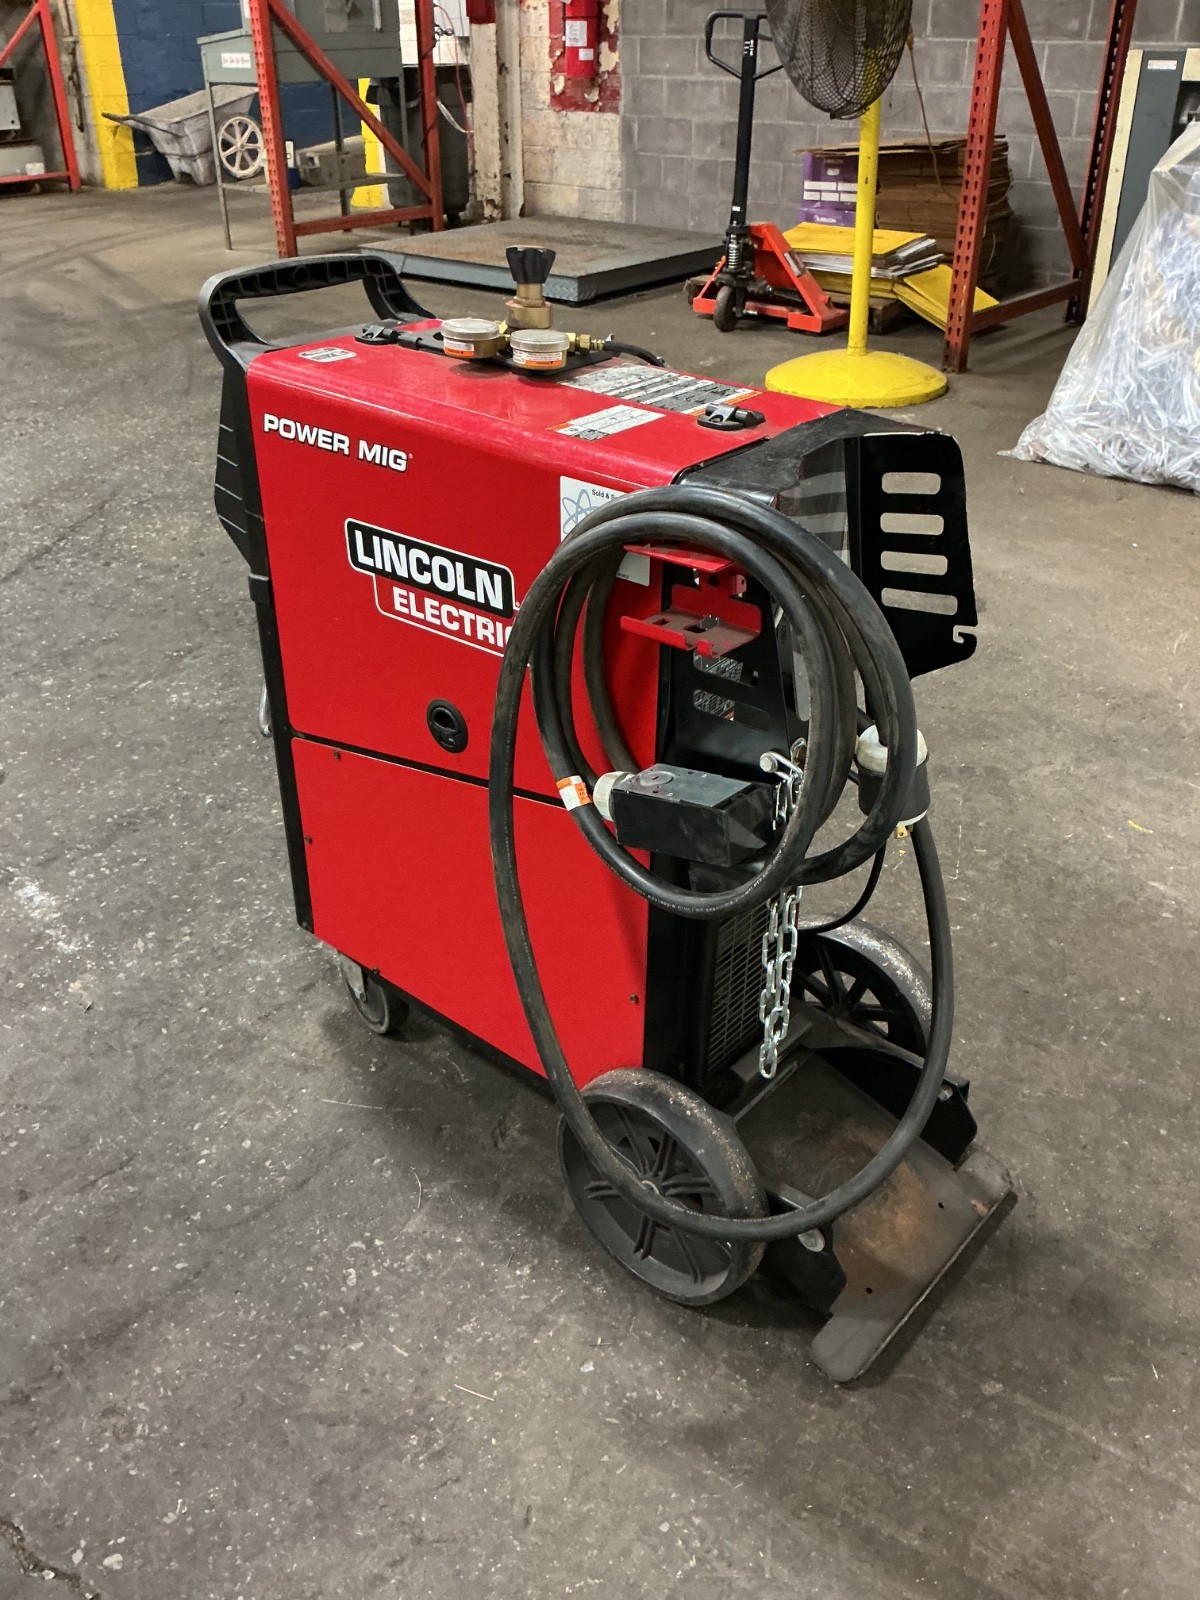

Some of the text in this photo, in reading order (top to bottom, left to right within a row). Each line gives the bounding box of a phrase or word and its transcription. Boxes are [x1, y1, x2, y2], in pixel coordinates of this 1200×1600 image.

[263, 413, 350, 456] POWER
[592, 489, 604, 498] Sold
[354, 529, 504, 610] LINCOLN
